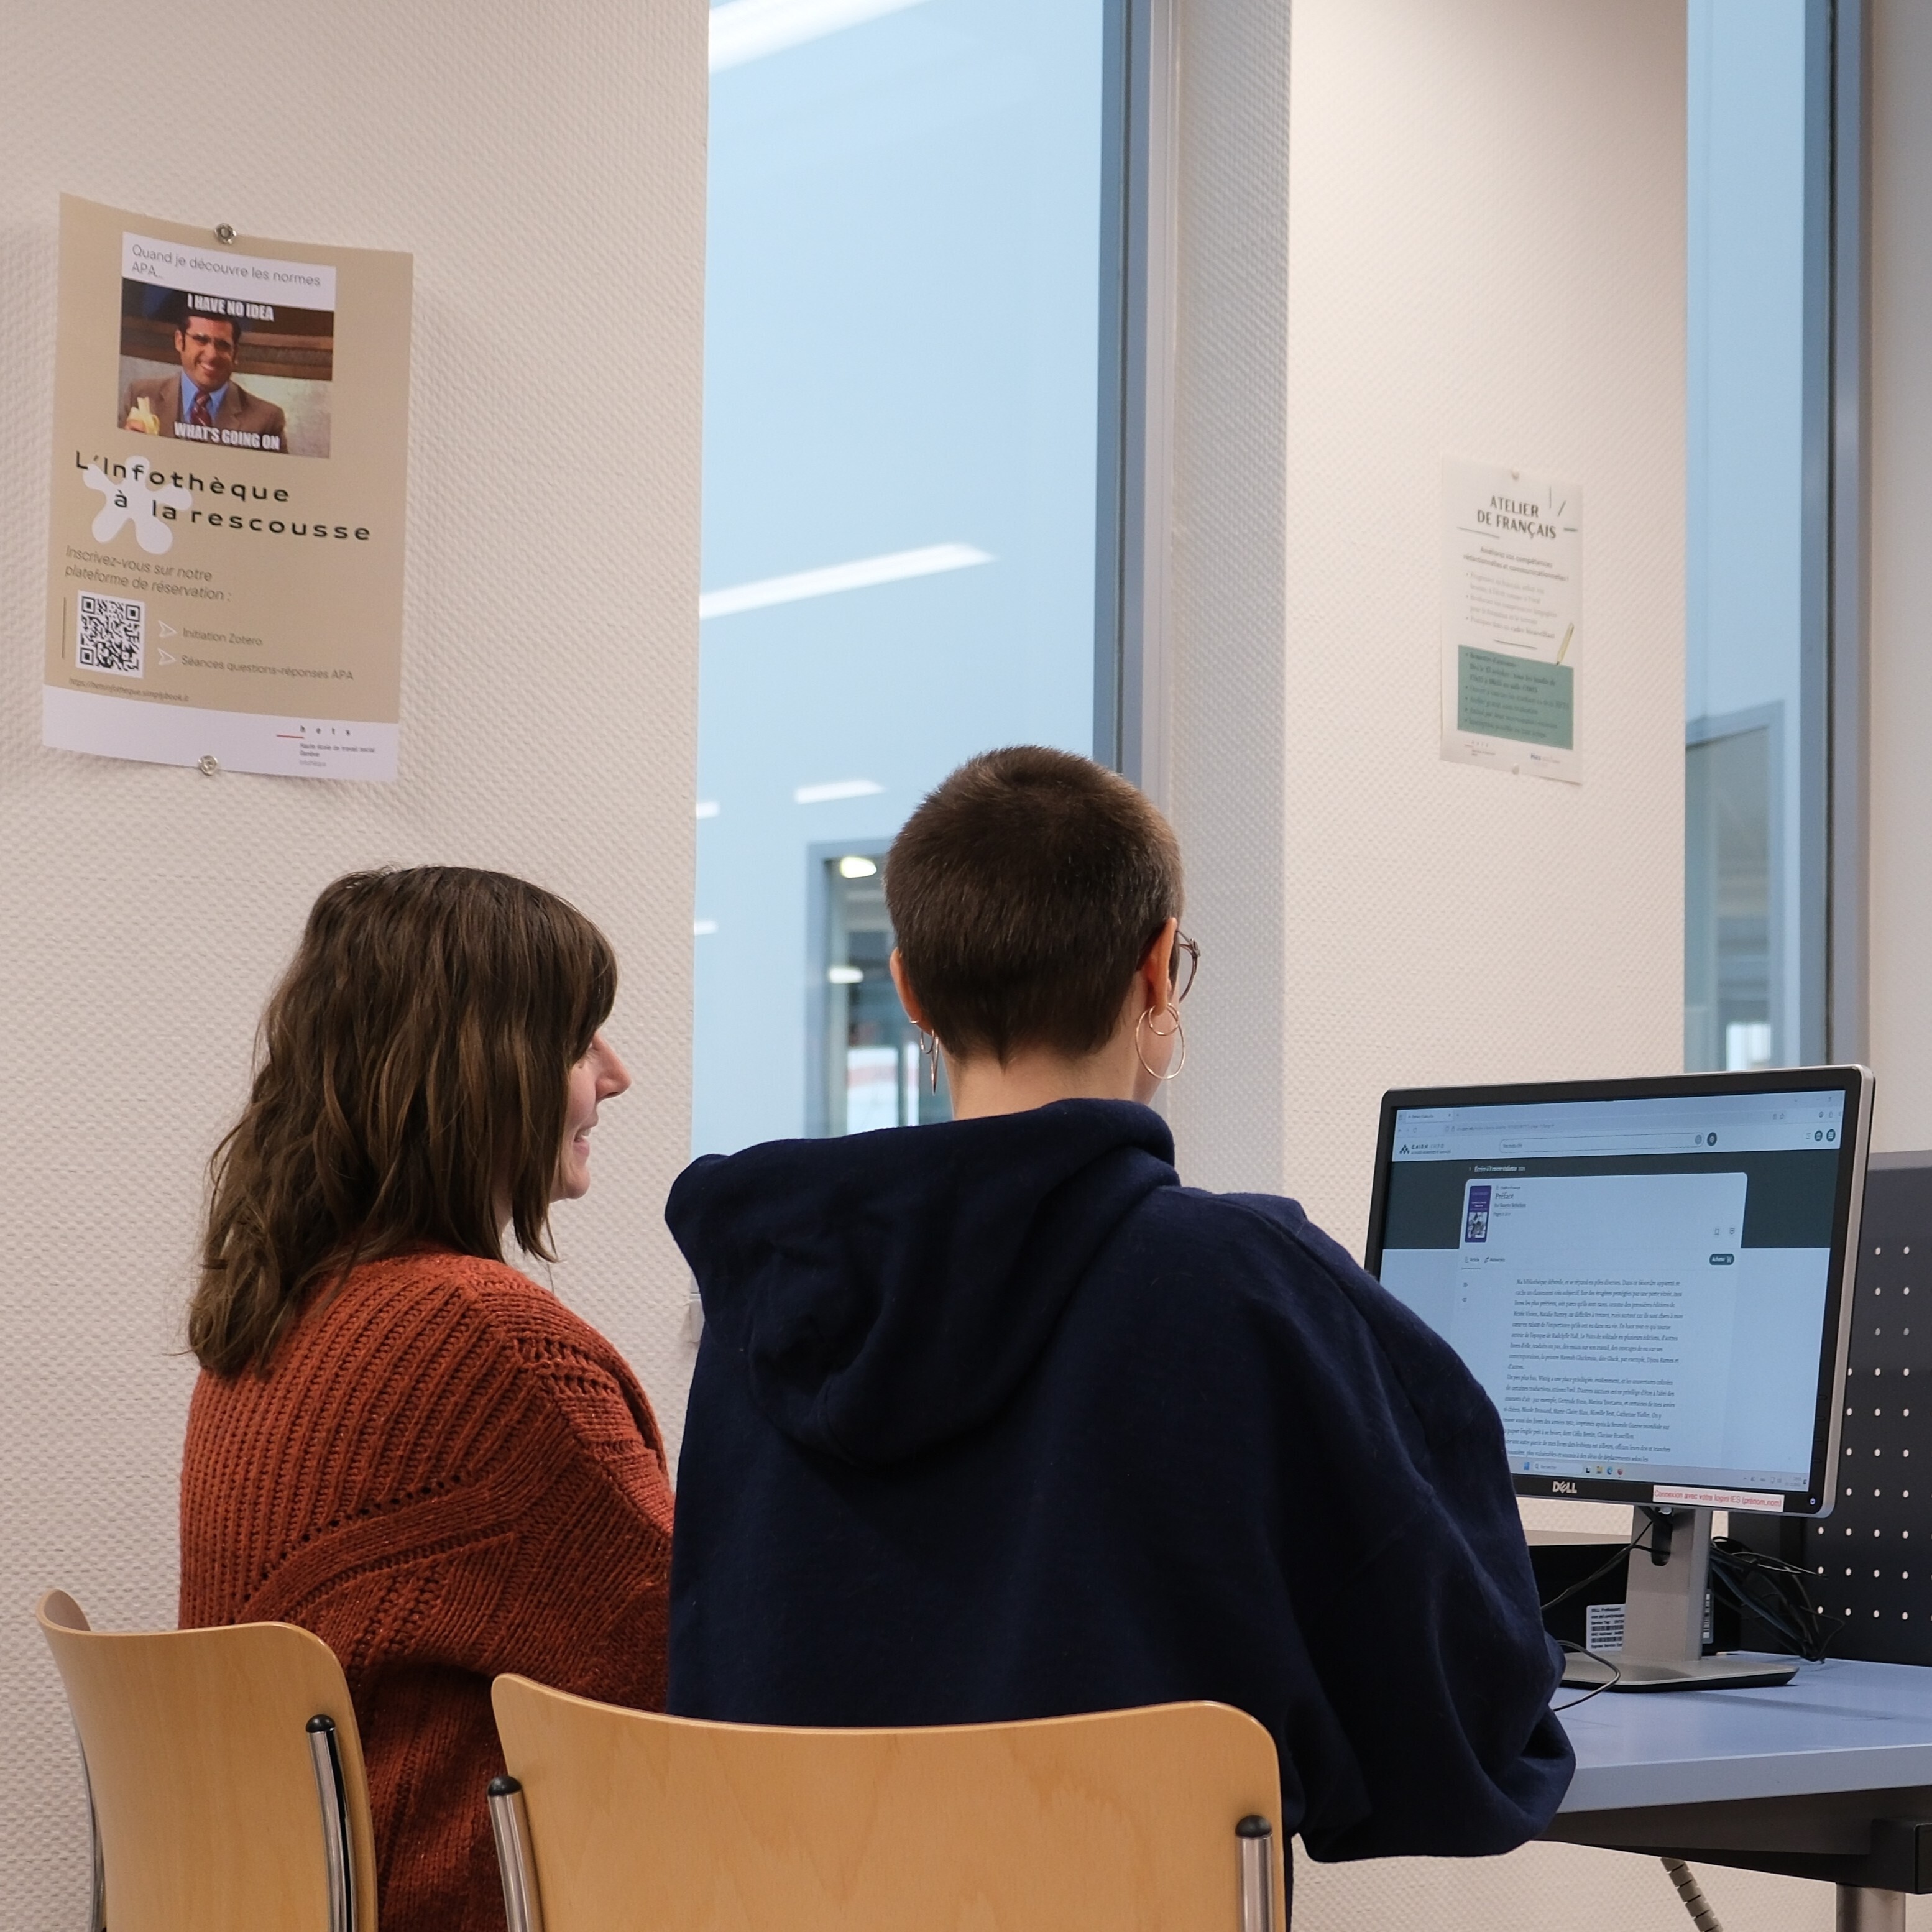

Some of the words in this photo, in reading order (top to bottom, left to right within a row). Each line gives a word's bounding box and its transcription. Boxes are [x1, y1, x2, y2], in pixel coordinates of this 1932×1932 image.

[132, 244, 173, 263] Quand
[174, 253, 186, 267] je
[190, 256, 249, 277] découvre
[251, 267, 269, 280] les
[273, 270, 321, 287] normes
[188, 293, 193, 309] I
[194, 295, 225, 314] HAVE
[226, 300, 244, 316] NO
[246, 303, 274, 322] IDEA
[173, 421, 221, 443] WHAT'S
[221, 427, 261, 449] GOING
[261, 433, 281, 451] ON
[114, 490, 129, 508] à
[152, 499, 177, 520] la
[191, 508, 371, 541] rescousse
[1489, 495, 1539, 518] ATELIER
[1477, 510, 1492, 526] DE
[1496, 513, 1557, 539] FRANÇAIS
[65, 545, 150, 574] Inscrivez-vous
[154, 561, 175, 577] sur
[177, 565, 213, 582] notre
[64, 564, 129, 589] plateforme
[132, 576, 149, 590] de
[151, 579, 224, 602] réservation
[183, 627, 226, 643] Initiation
[229, 633, 262, 646] Zotero
[181, 653, 225, 671] Séances
[331, 669, 354, 680] APA
[1494, 1191, 1514, 1199] Préface
[1552, 1481, 1578, 1494] DELL
[1654, 1489, 1683, 1499] Connexion
